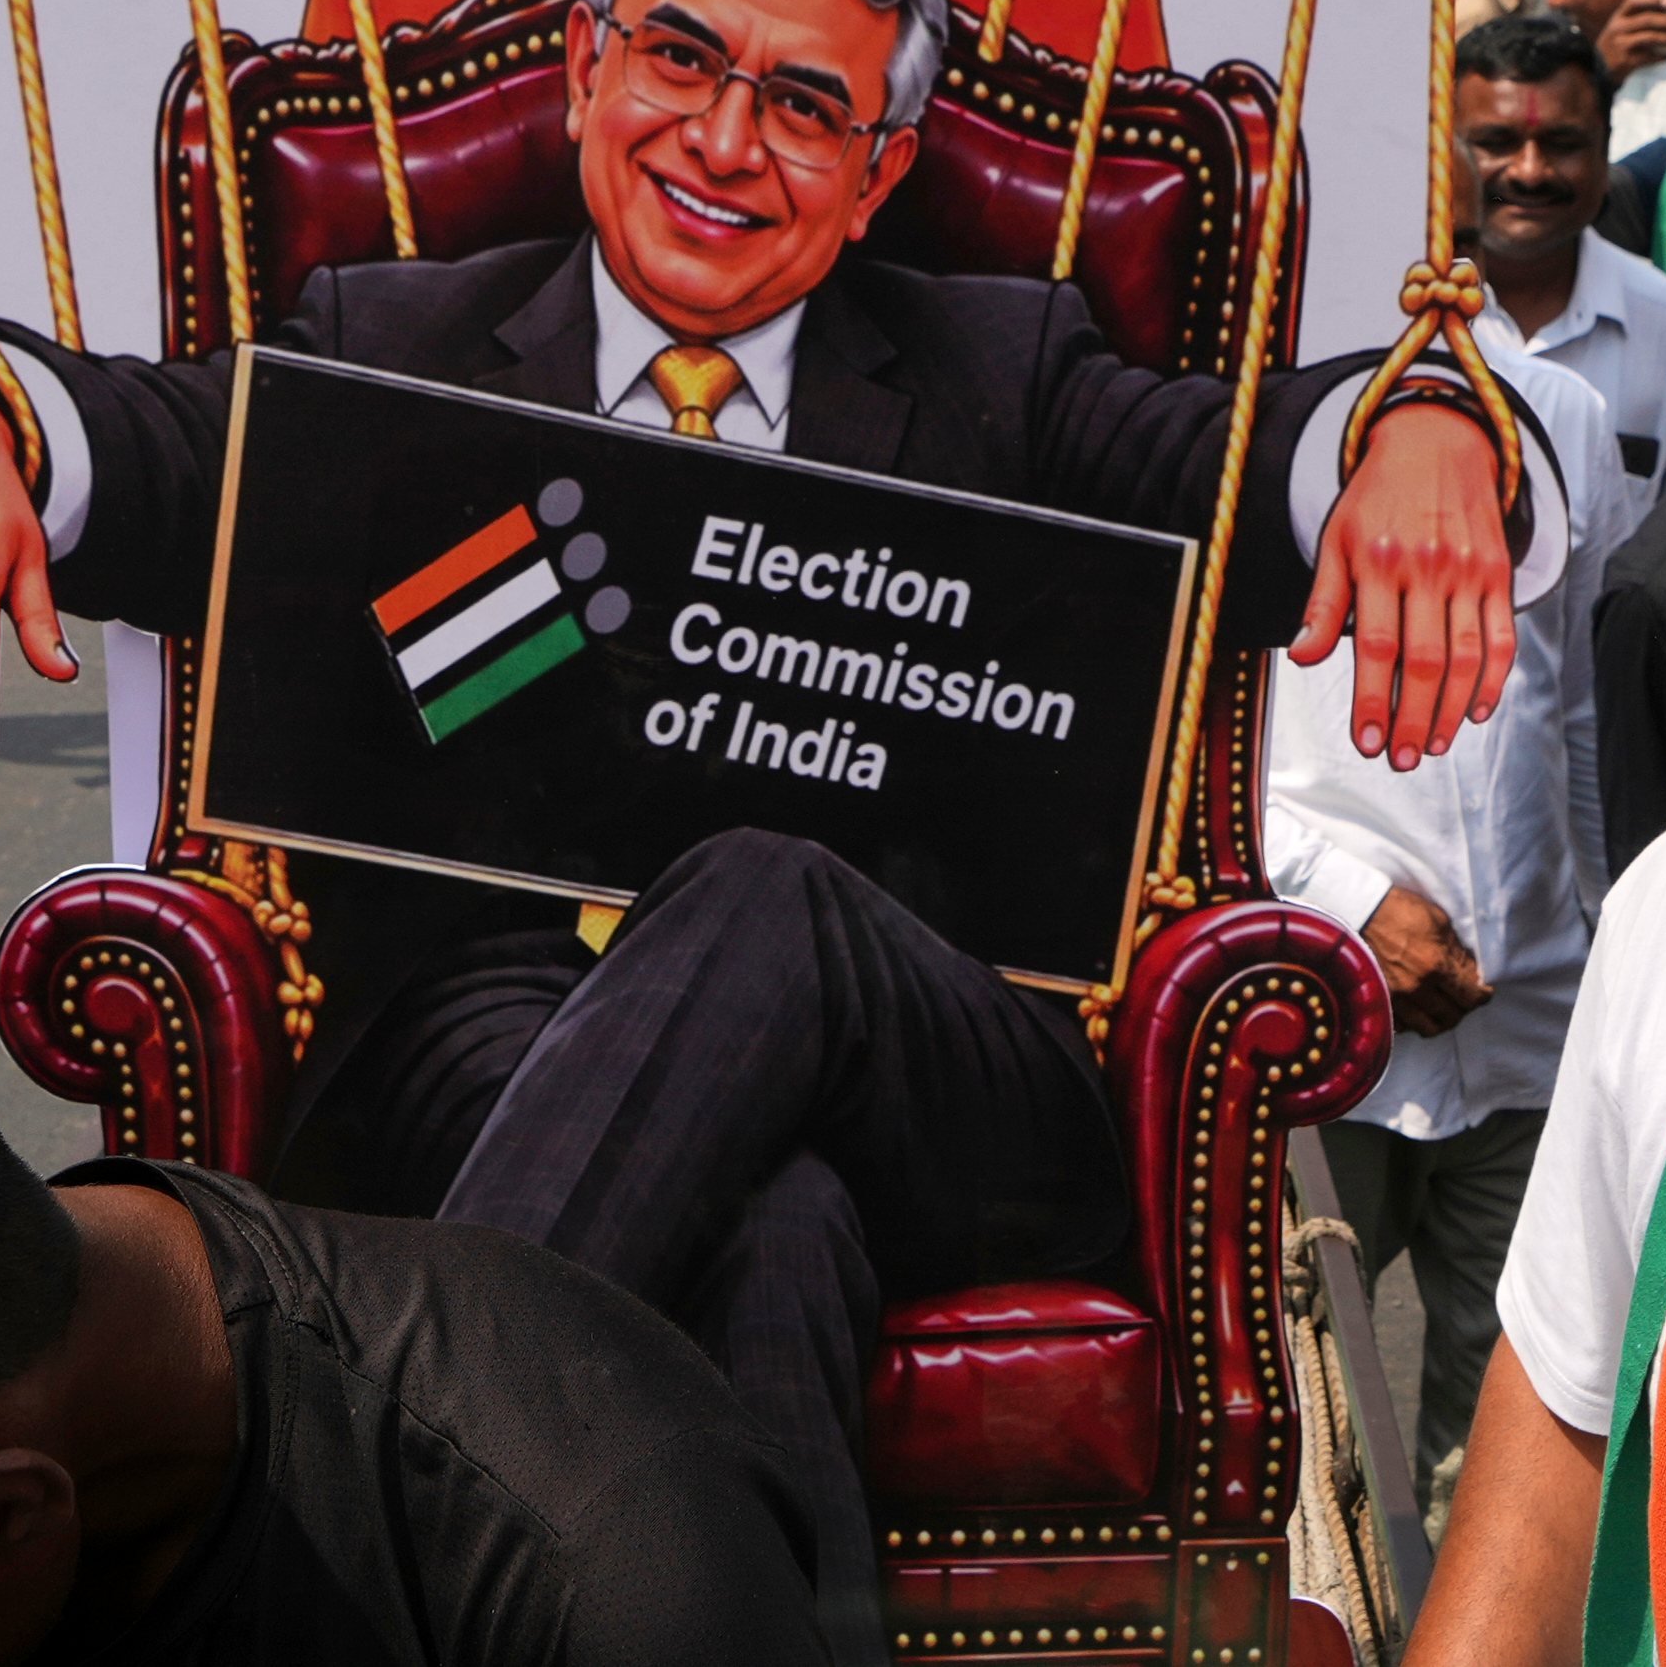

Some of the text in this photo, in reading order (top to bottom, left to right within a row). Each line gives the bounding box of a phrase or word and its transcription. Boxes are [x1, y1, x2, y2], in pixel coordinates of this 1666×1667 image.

[690, 515, 972, 629] Election
[669, 602, 1076, 741] Commission
[644, 692, 888, 791] of India
